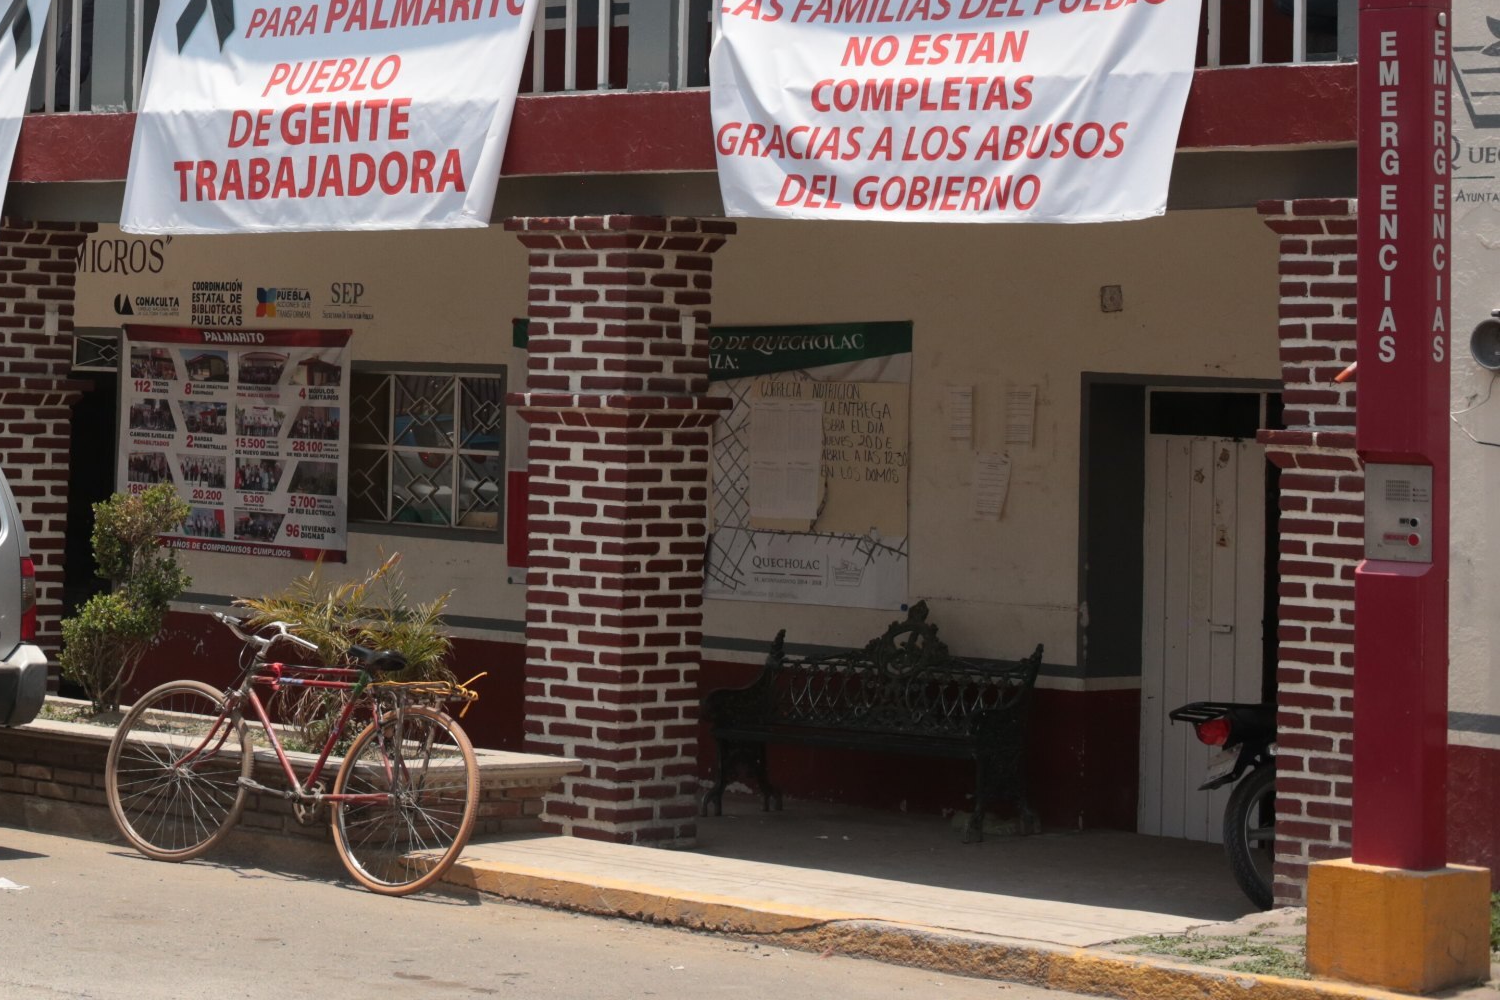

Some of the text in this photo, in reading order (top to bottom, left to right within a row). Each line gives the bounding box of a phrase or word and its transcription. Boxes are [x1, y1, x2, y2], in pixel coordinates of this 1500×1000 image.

[245, 6, 316, 39] PARA
[840, 30, 1030, 67] NO ESTAN
[261, 54, 402, 97] PUEBLO
[810, 75, 1034, 113] COMPLETAS
[227, 97, 412, 148] DE GENTE
[716, 121, 1128, 162] GRACIAS A LOS ABUSOS
[173, 148, 466, 203] TRABAJADORA
[775, 173, 1041, 211] DEL GOBIERNO
[1378, 31, 1400, 364] EMERGENCIAS
[1433, 30, 1447, 364] EMERGENCIAS
[192, 293, 242, 303] ESTATAL DE
[276, 291, 311, 301] PUEBLA
[331, 281, 364, 304] SEP
[135, 295, 179, 308] CONACULTA
[192, 304, 242, 315] BIBLIOTECAS
[191, 315, 243, 326] PUBLICAS
[204, 331, 265, 343] PALMARITO
[724, 335, 750, 350] DE
[752, 333, 866, 355] QUECHOLAC
[134, 380, 151, 393] 112
[184, 382, 192, 395] 8
[299, 388, 306, 399] 4
[812, 383, 860, 400] NUTRICION
[824, 401, 892, 419] LA ENTREGA
[851, 419, 864, 433] EL
[867, 420, 884, 434] DIA
[186, 435, 193, 448] 2
[285, 524, 300, 538] 96
[300, 531, 325, 540] DIGNAS
[301, 524, 336, 534] VIVIENDAS
[202, 542, 251, 554] COMPROMISOS
[252, 547, 291, 558] CUMPLIDOS
[752, 555, 820, 570] QUECHOLAC
